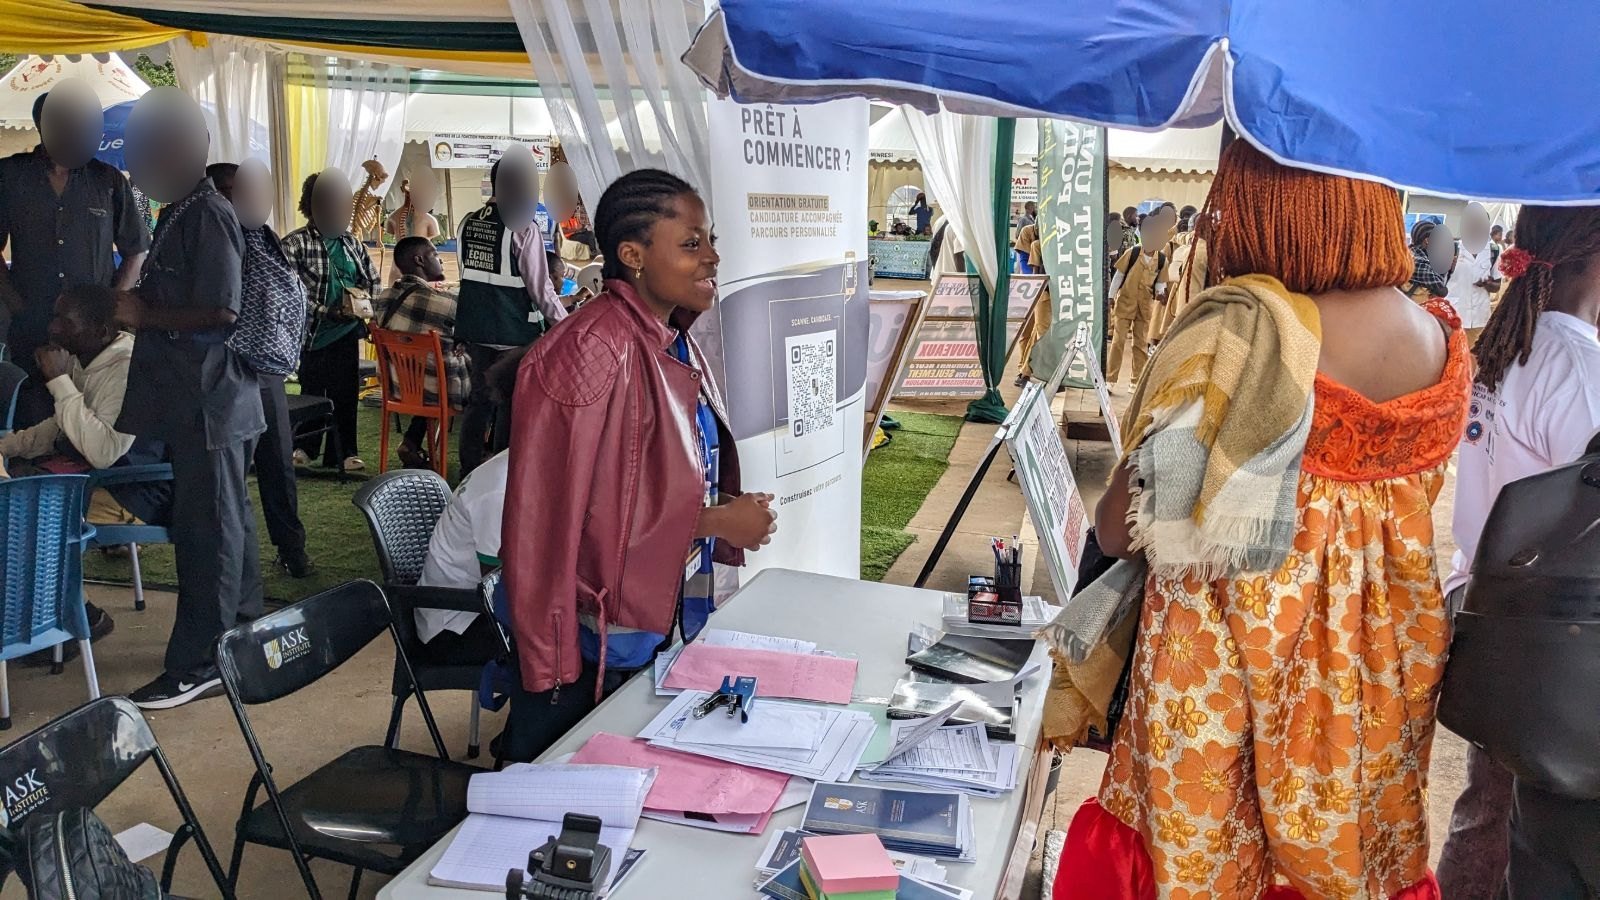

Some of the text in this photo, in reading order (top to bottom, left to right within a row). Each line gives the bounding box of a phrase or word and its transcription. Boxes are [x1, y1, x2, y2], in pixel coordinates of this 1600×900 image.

[741, 104, 803, 139] PRÊT À
[743, 138, 852, 172] COMMENCER ?
[749, 196, 829, 209] ORIENTATION GRATUITE
[750, 210, 843, 223] CANDIDATURE ACCOMPAGNÉE
[751, 224, 837, 238] PARCOURS PERSONNALISÉ
[779, 488, 813, 506] Construisez
[281, 626, 309, 652] ASK
[5, 767, 45, 808] ASK
[8, 785, 49, 817] INSTITUTE
